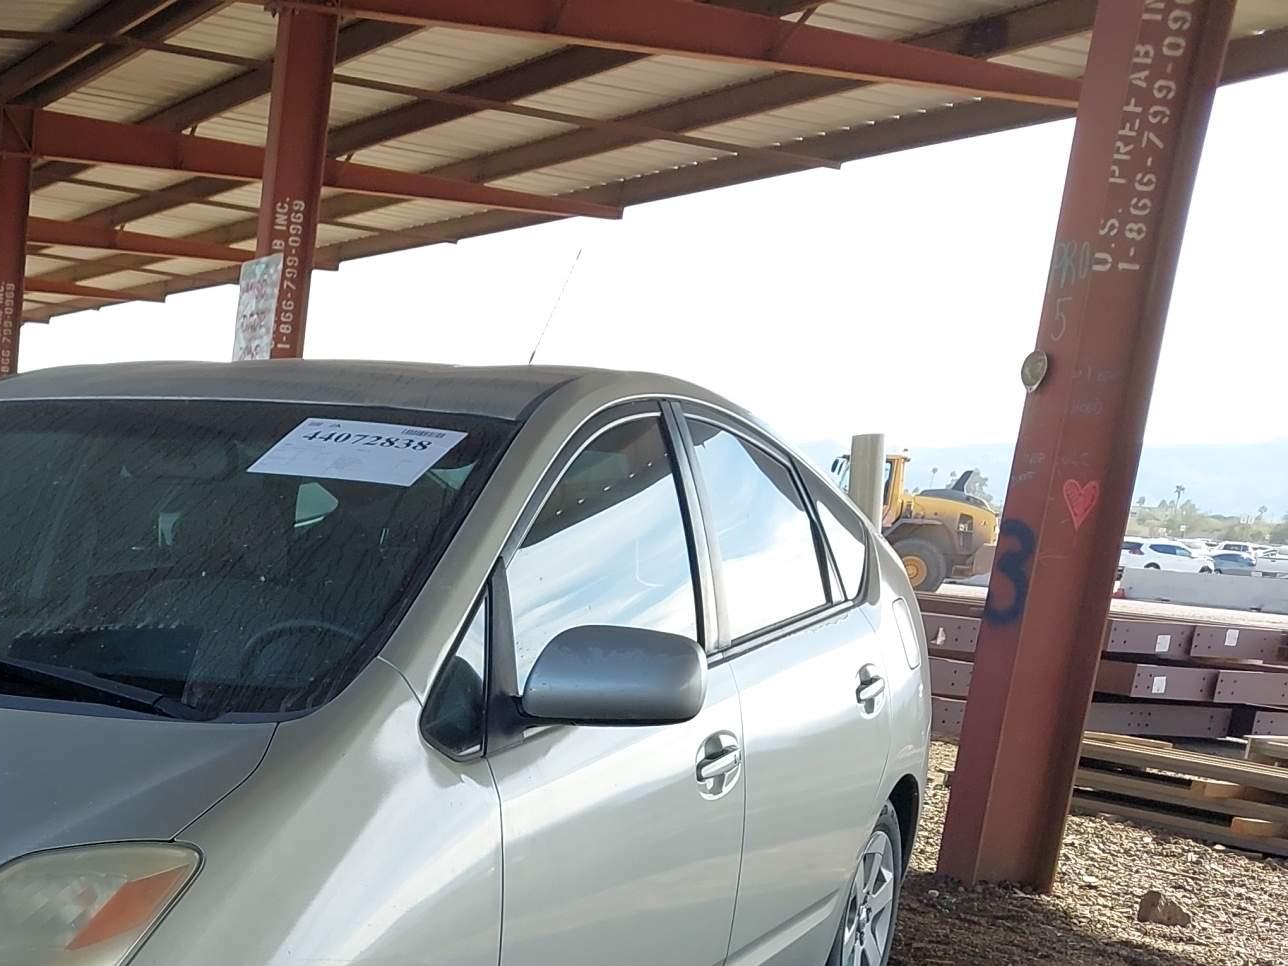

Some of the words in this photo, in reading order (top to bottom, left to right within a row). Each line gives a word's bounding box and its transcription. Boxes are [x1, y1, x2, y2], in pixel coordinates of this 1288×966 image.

[1092, 208, 1123, 272] U.S.
[1108, 43, 1156, 184] PREFAB
[1117, 0, 1196, 272] 1-866-799-09
[274, 196, 292, 233] INC.
[276, 200, 306, 350] 1-866-799-0969
[302, 429, 433, 452] 44072838
[985, 518, 1036, 627] 3
